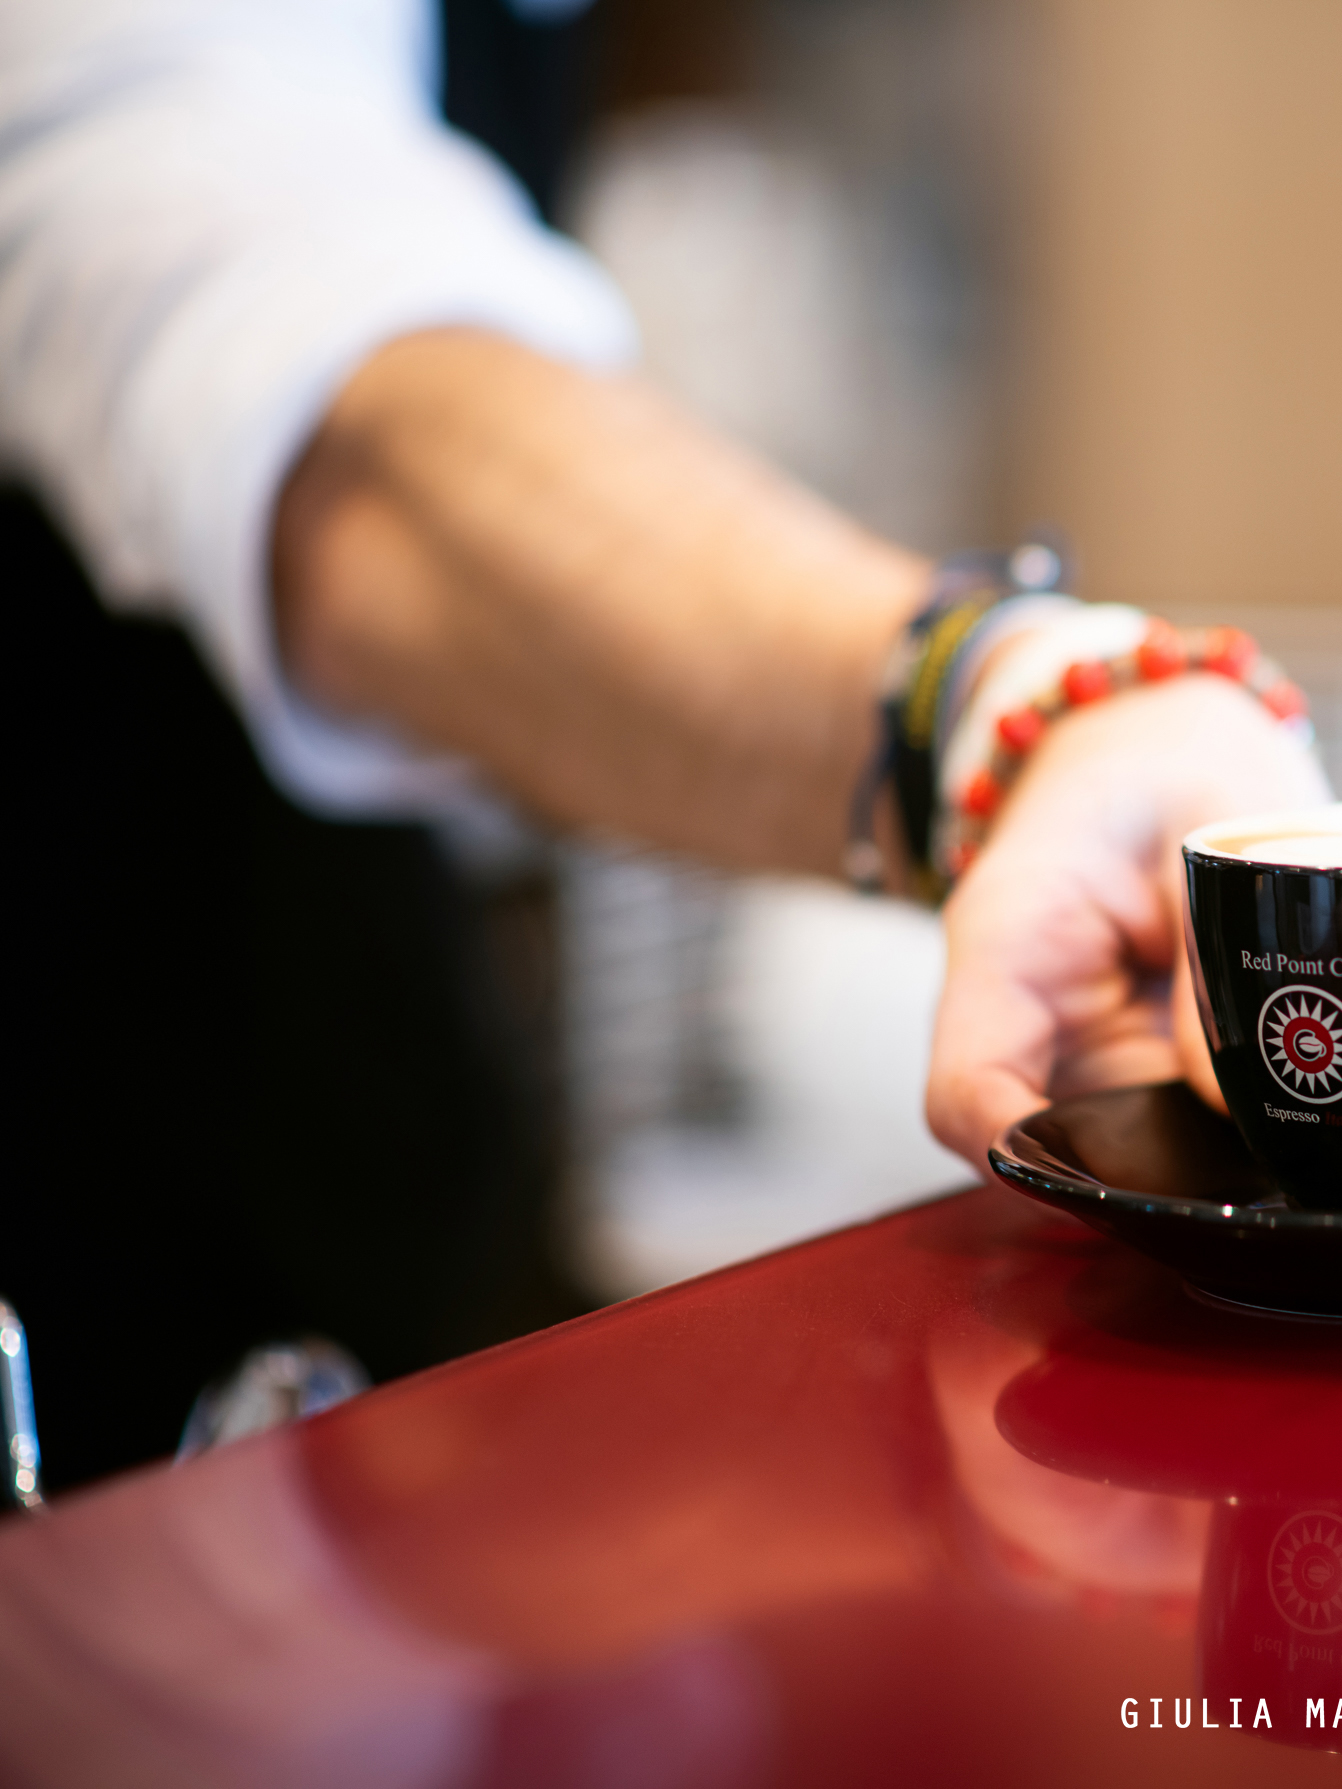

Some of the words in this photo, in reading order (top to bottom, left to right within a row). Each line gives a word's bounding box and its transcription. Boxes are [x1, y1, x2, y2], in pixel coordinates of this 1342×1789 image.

[1241, 950, 1272, 971] Red
[1276, 953, 1324, 977] Point
[1264, 1102, 1320, 1123] Espresso
